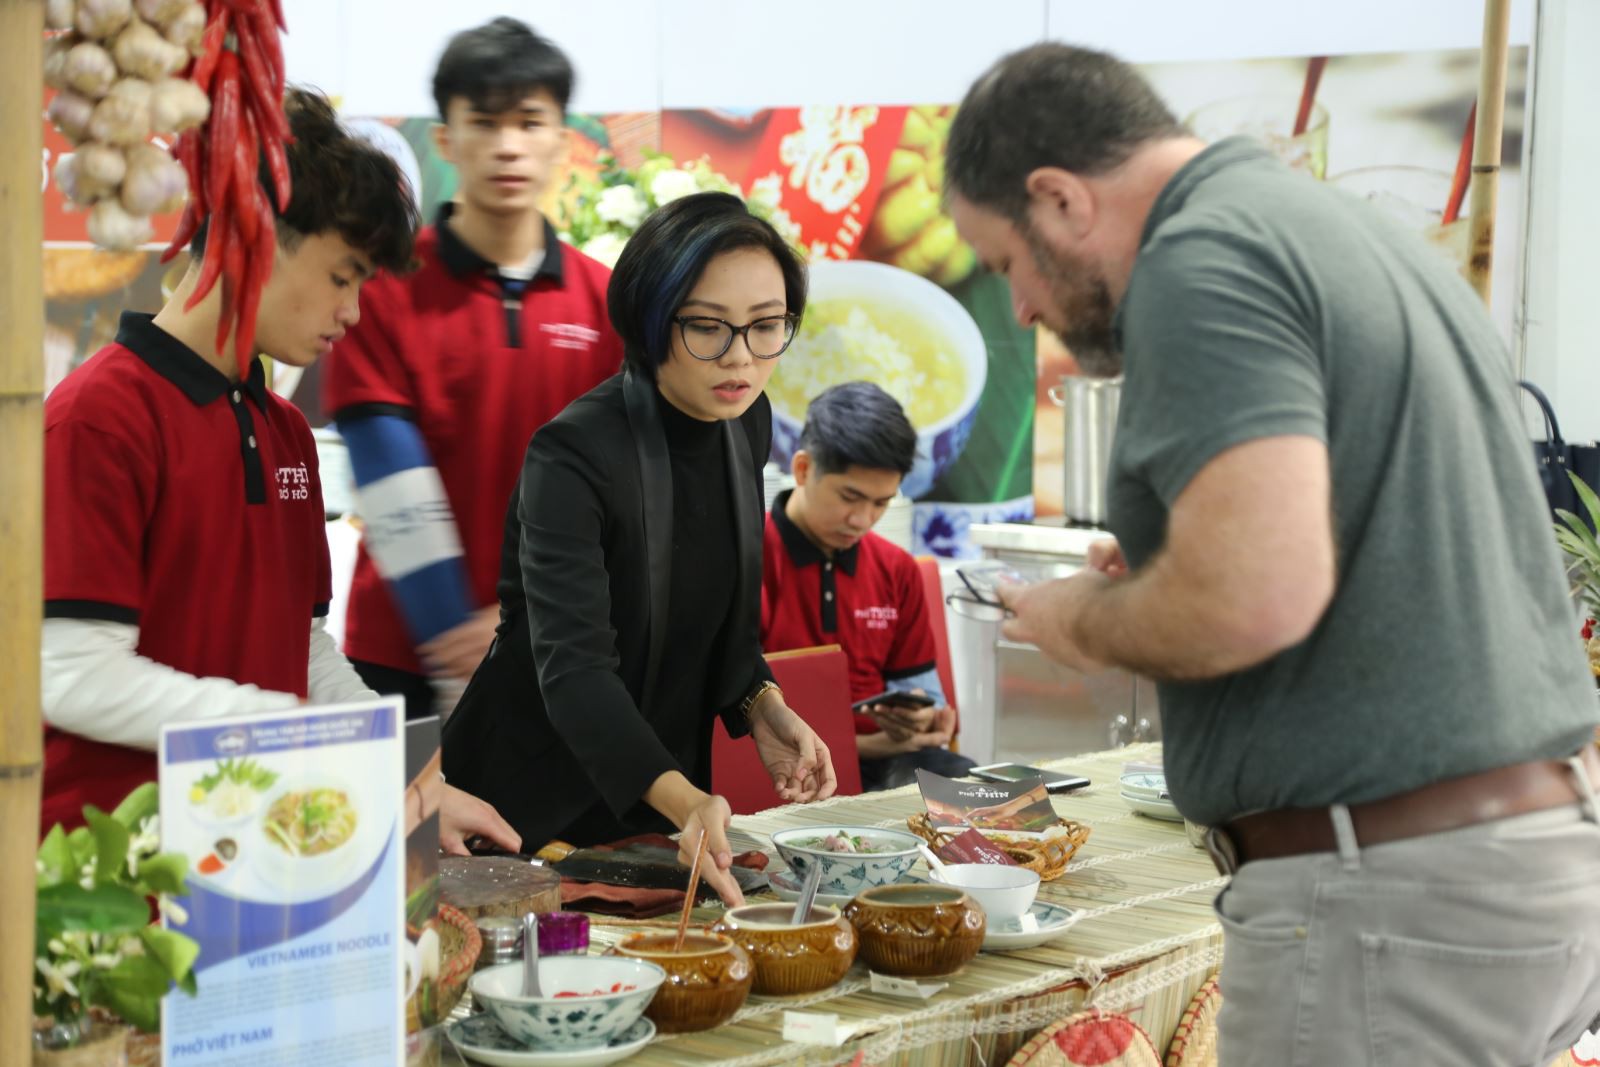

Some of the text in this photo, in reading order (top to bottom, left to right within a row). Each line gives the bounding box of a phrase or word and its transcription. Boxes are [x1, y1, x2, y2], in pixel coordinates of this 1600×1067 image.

[247, 933, 391, 969] VIETNAMESE NOODLE
[171, 1026, 274, 1059] PHỞ VIỆT NAM
